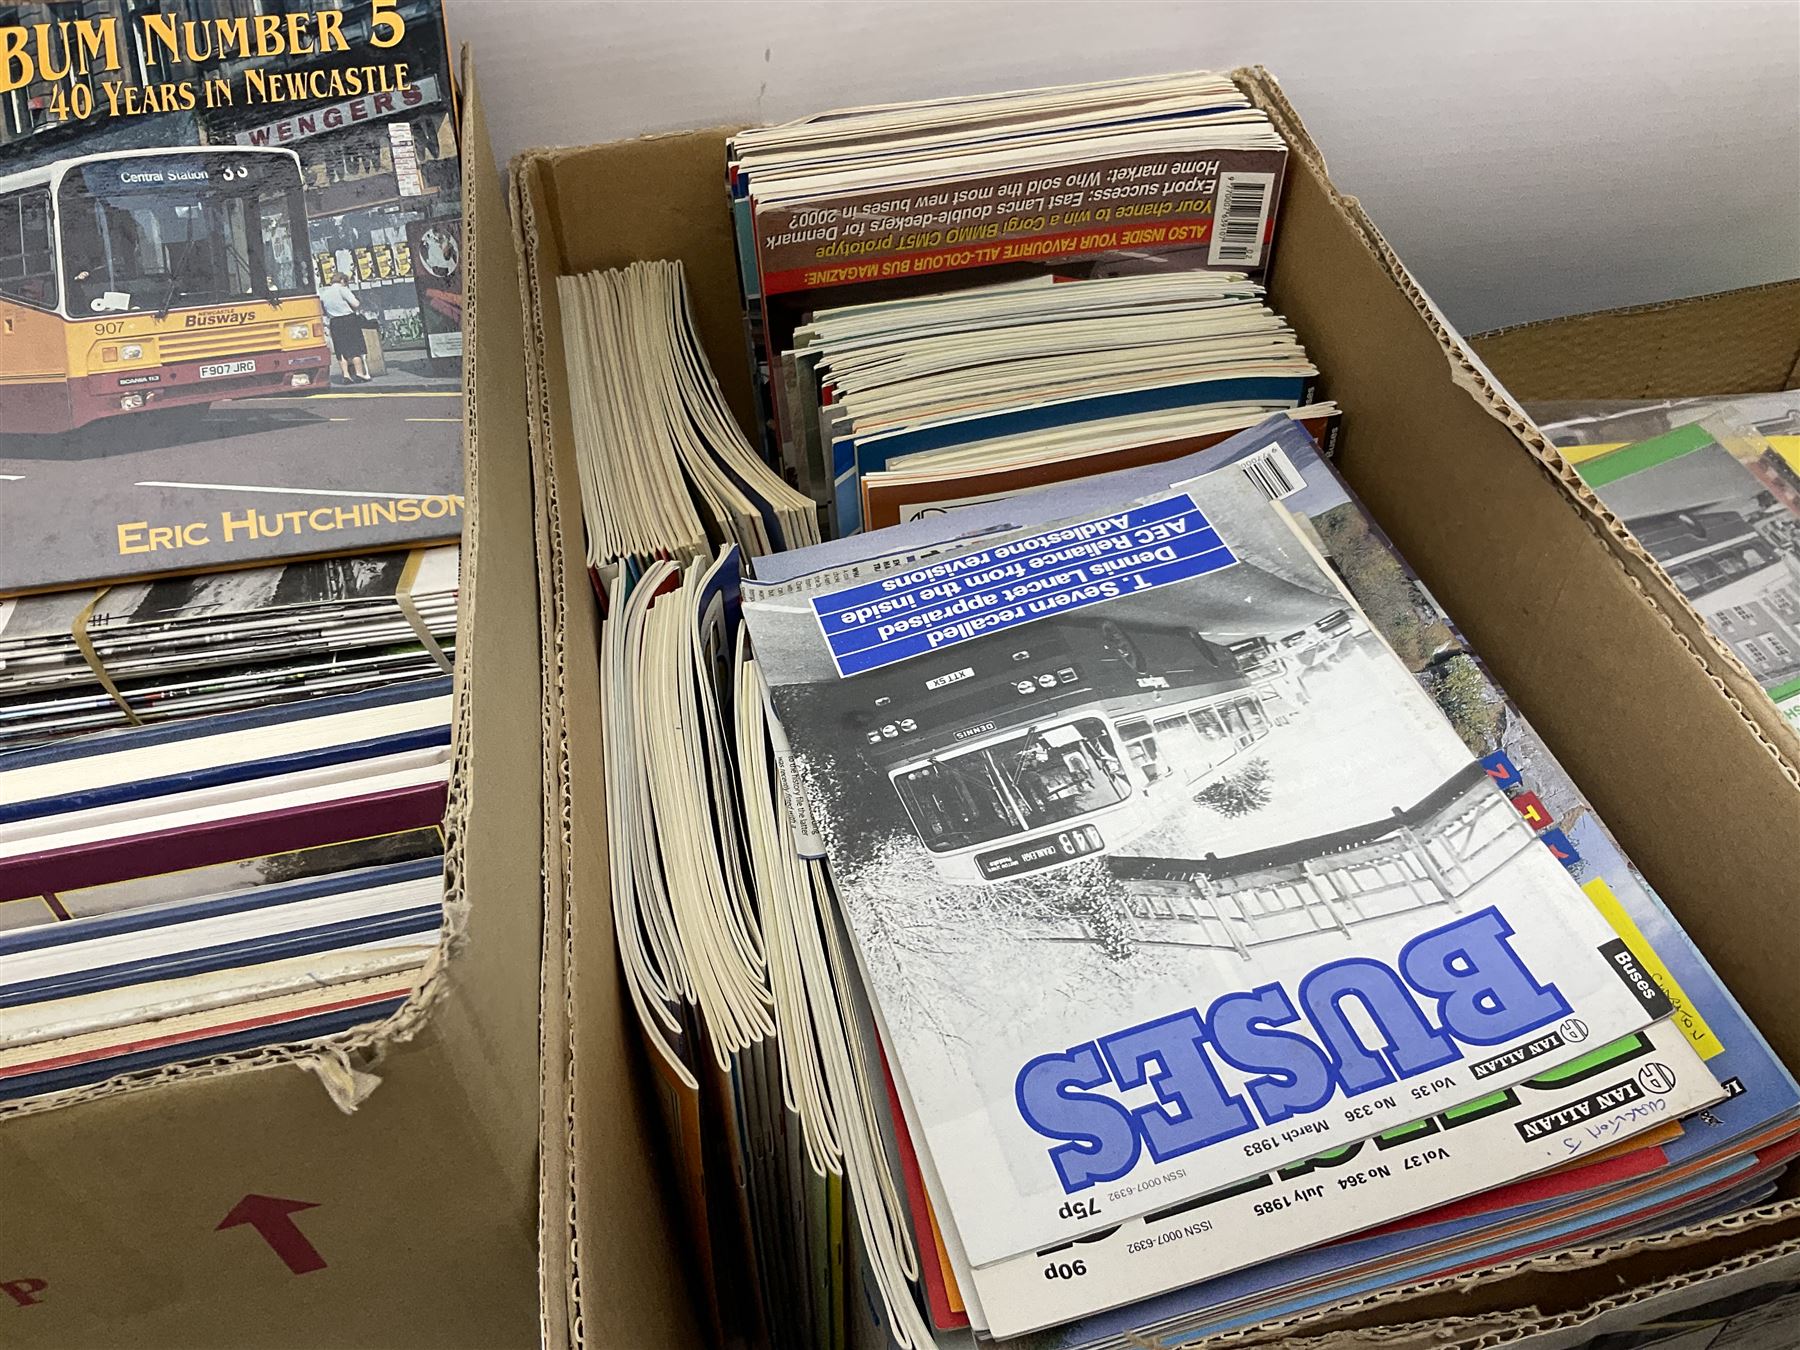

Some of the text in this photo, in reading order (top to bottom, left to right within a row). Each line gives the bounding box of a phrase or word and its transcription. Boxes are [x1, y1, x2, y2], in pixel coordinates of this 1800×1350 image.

[369, 0, 406, 48] 5
[49, 63, 414, 121] 40 YEARS IN NEWCASTLE
[121, 172, 163, 183] Central
[788, 160, 1220, 229] Home market: Who sold the most new buses in 2000?
[766, 176, 1216, 250] Export success: East Lancs double-deckers for Denmark
[815, 199, 1212, 259] Your chance to win a Corgi BMMO CM5T prototype
[803, 225, 1207, 284] ALSO INSIDE YOUR FAVOURITE ALL-COLOUR BUS MAGAZINE:
[94, 321, 125, 336] 907
[185, 310, 255, 328] Busways
[201, 361, 254, 376] F907 JRG
[117, 522, 209, 555] ERIC
[994, 514, 1128, 559] Addlestone
[840, 517, 1186, 624] AEC Reliance from the inside
[877, 545, 1177, 641] Dennis Lancet appraised
[881, 553, 990, 591] revisions
[926, 573, 1152, 647] T. Severn recalled
[956, 722, 994, 739] DENNIS
[1615, 950, 1655, 1000] Buses
[1015, 905, 1574, 1194] BUSES
[1474, 1034, 1560, 1077] IAN ALLAN
[1243, 1076, 1456, 1157] Vol 35 No 336 March 1983
[1522, 1083, 1638, 1138] IAN ALLAN
[1107, 1168, 1186, 1202] ISSN 0007-6392
[1253, 1147, 1450, 1216] Vol 37 No 364 July 1985
[1058, 1197, 1101, 1220] 75p
[1126, 1220, 1212, 1254] ISSN 0007-6392
[1044, 1259, 1087, 1280] 90p
